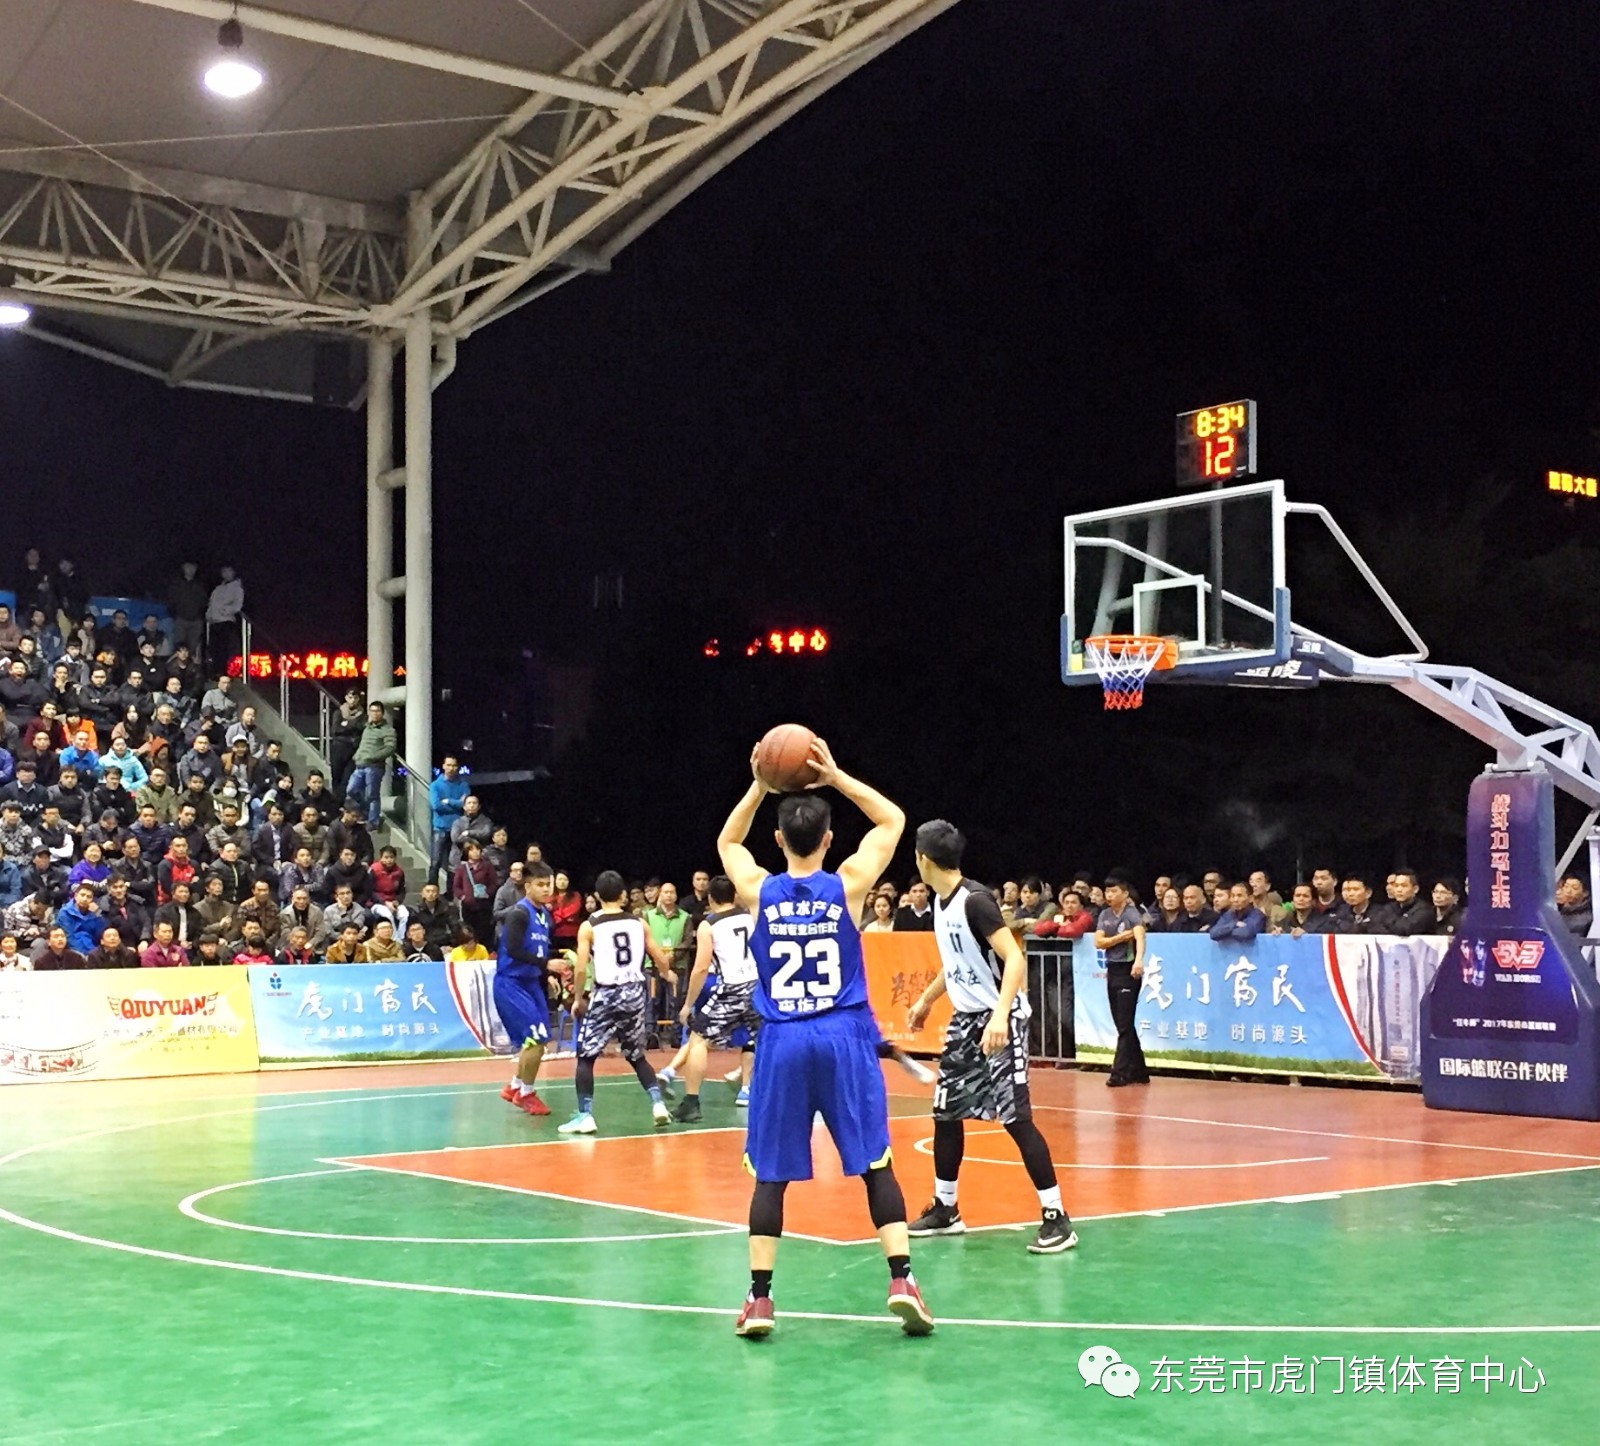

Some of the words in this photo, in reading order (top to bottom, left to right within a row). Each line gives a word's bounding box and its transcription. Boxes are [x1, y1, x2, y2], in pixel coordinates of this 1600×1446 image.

[1196, 405, 1245, 437] 8:34
[1205, 435, 1235, 476] 12
[613, 931, 633, 967] 8
[733, 926, 748, 960] 7
[950, 932, 963, 953] 11
[769, 938, 842, 999] 23
[120, 995, 208, 1020] QIUYUAN
[1138, 1020, 1208, 1041] 产业基地
[1231, 1023, 1308, 1045] 时尚源头
[1439, 1057, 1569, 1084] 国际篮联合作伙伴
